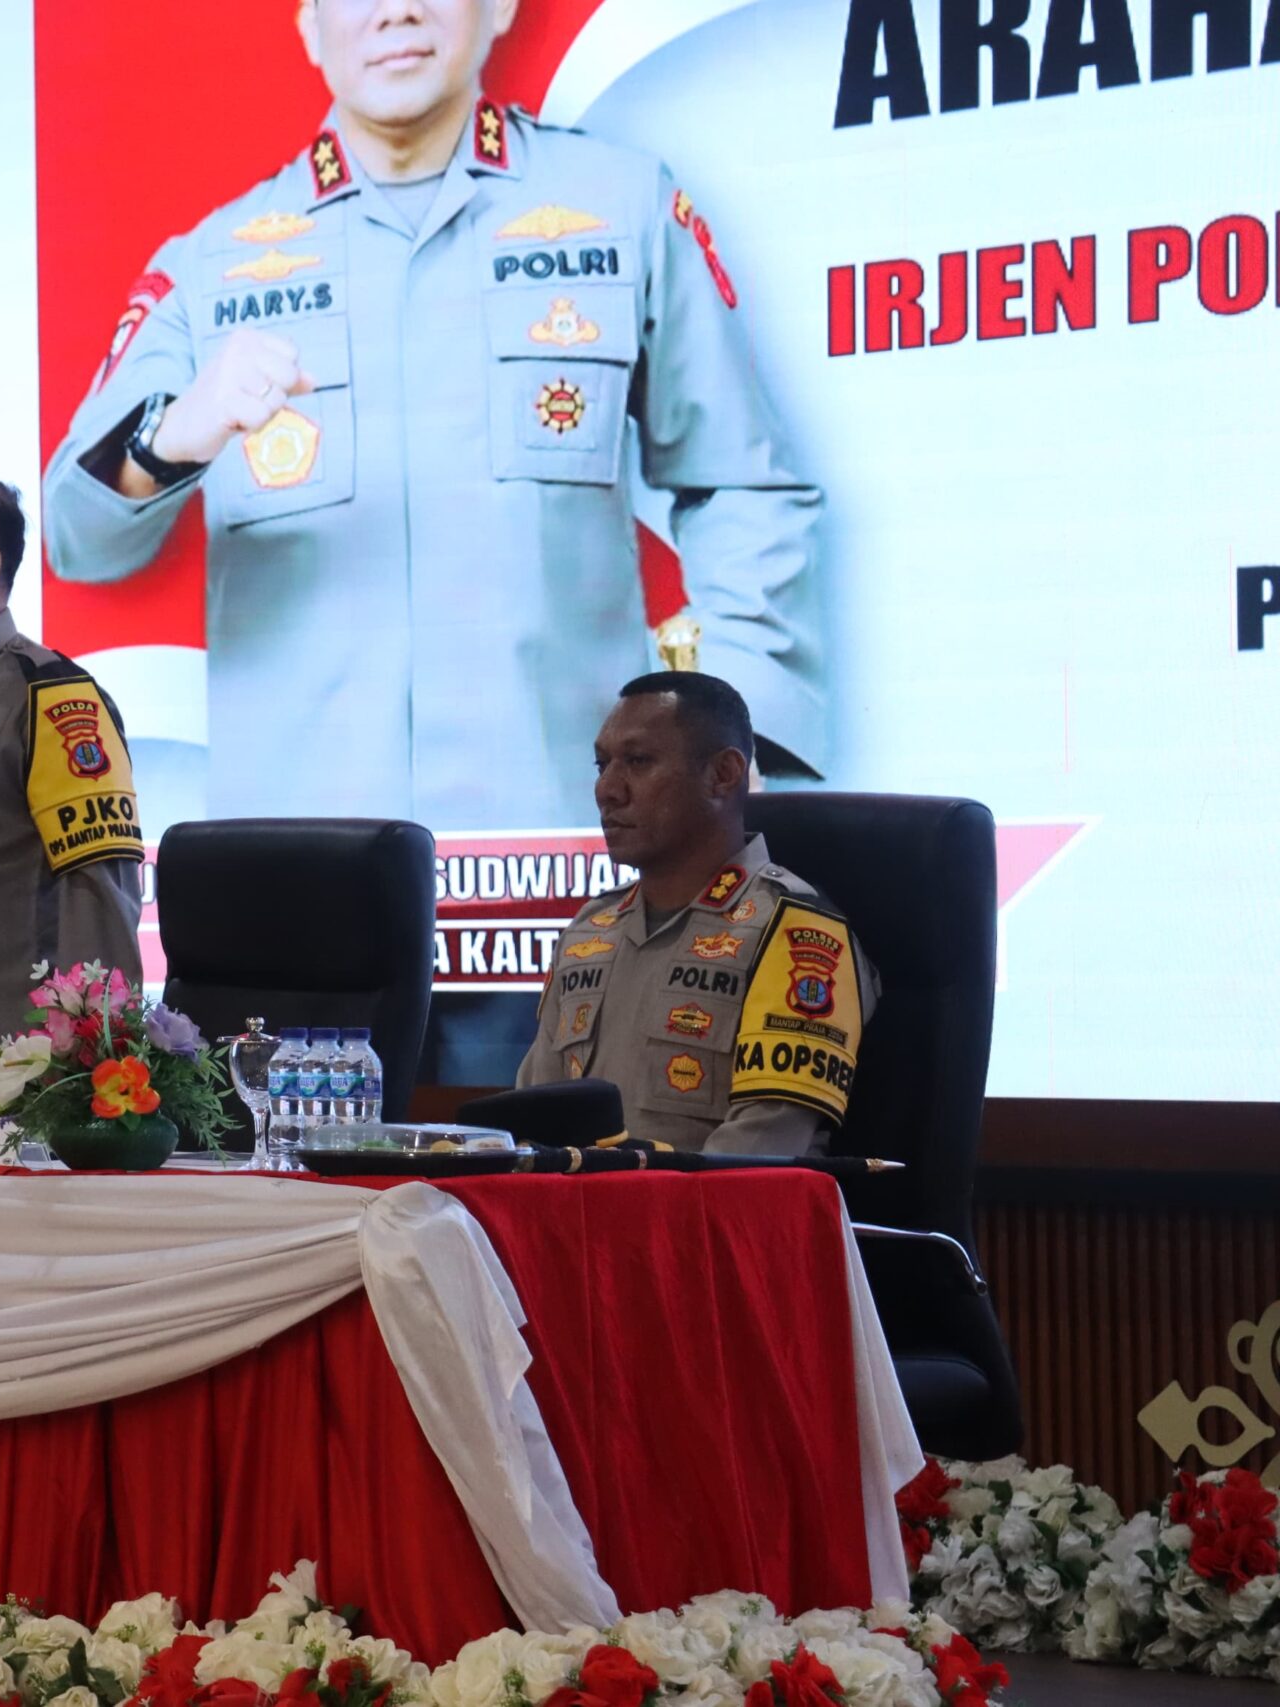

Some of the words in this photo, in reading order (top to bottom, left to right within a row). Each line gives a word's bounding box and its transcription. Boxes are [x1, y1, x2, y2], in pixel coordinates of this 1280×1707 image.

[833, 0, 1280, 130] ARAH
[493, 246, 620, 283] POLRI
[827, 234, 1097, 358] IRJEN
[1127, 211, 1280, 325] PO
[214, 282, 334, 326] HARY.S
[52, 702, 95, 717] POLDA
[57, 795, 134, 833] PJKO
[793, 929, 840, 950] POLRES
[668, 965, 740, 997] POLRI
[735, 1041, 765, 1074] KA
